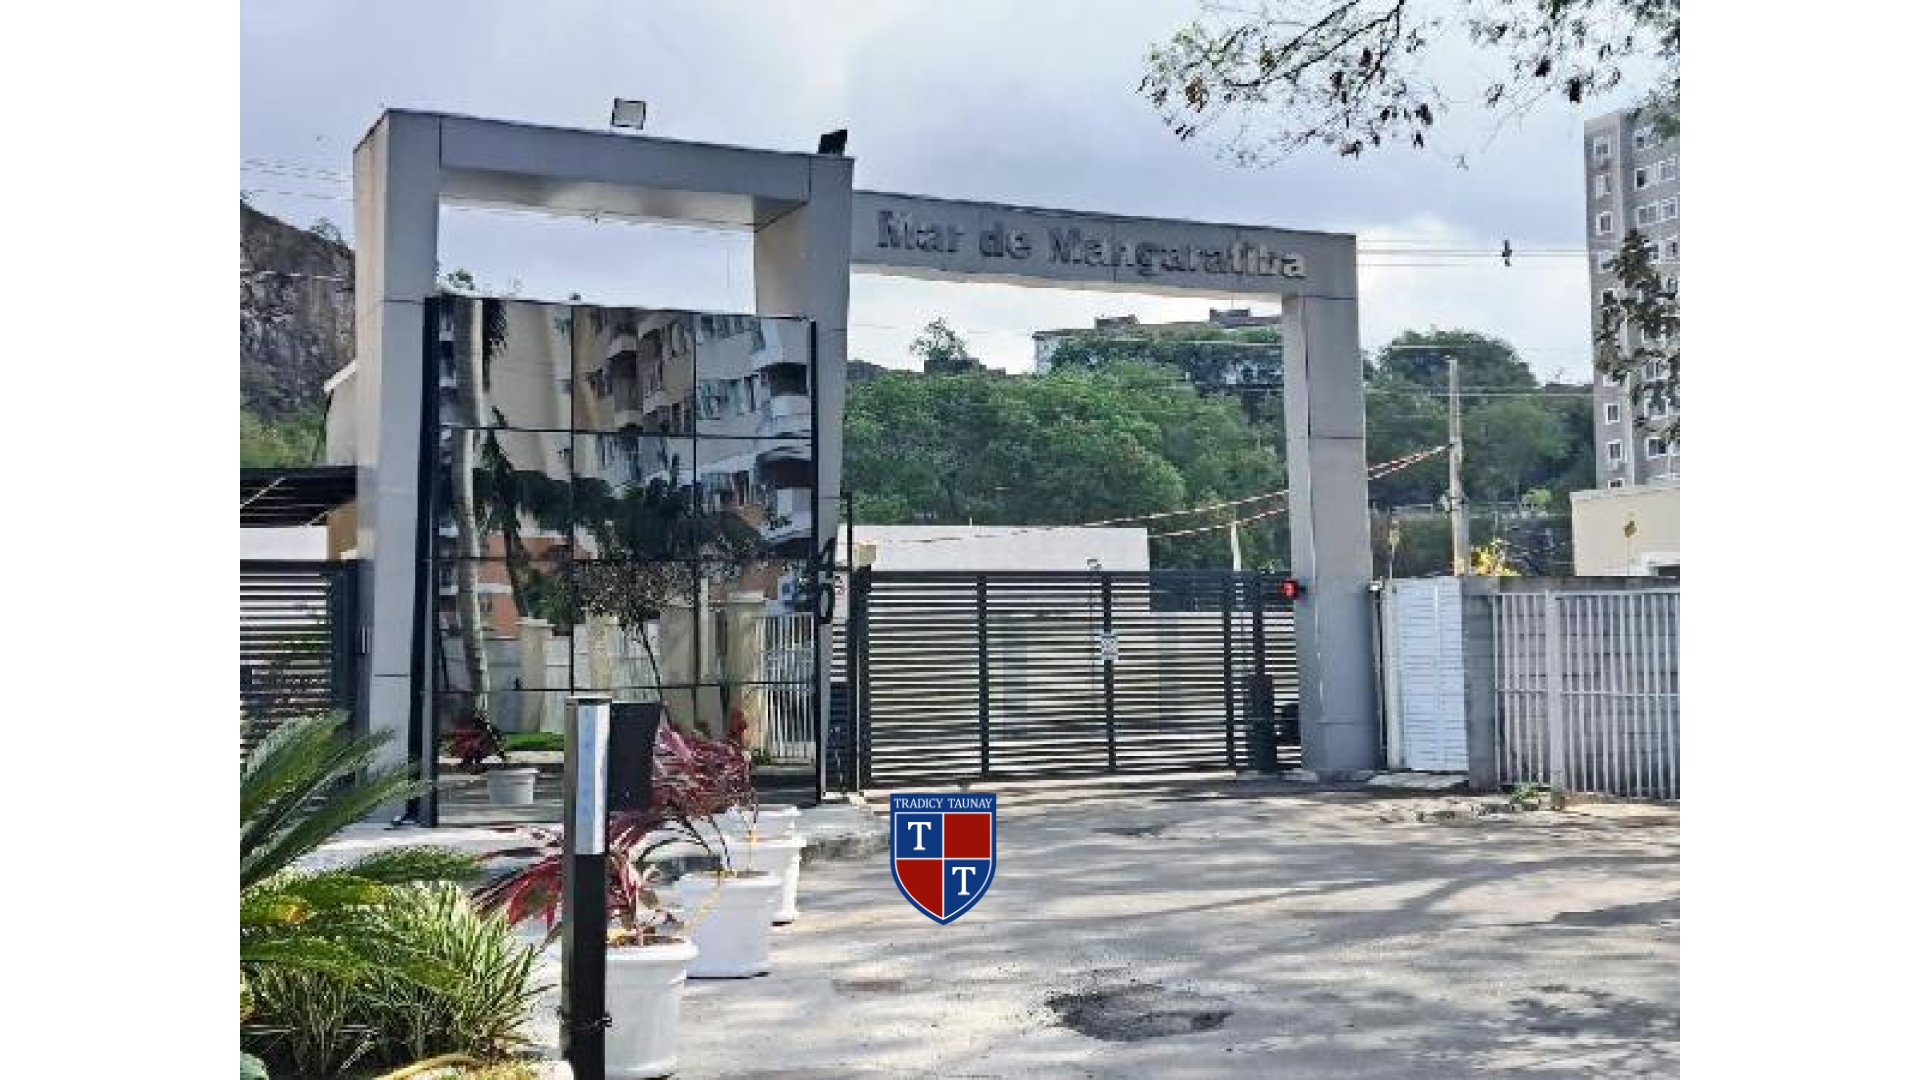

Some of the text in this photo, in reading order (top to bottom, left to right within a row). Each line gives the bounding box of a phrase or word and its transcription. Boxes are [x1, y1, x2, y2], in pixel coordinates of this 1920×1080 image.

[876, 210, 1308, 280] Mar de Mangaratiba
